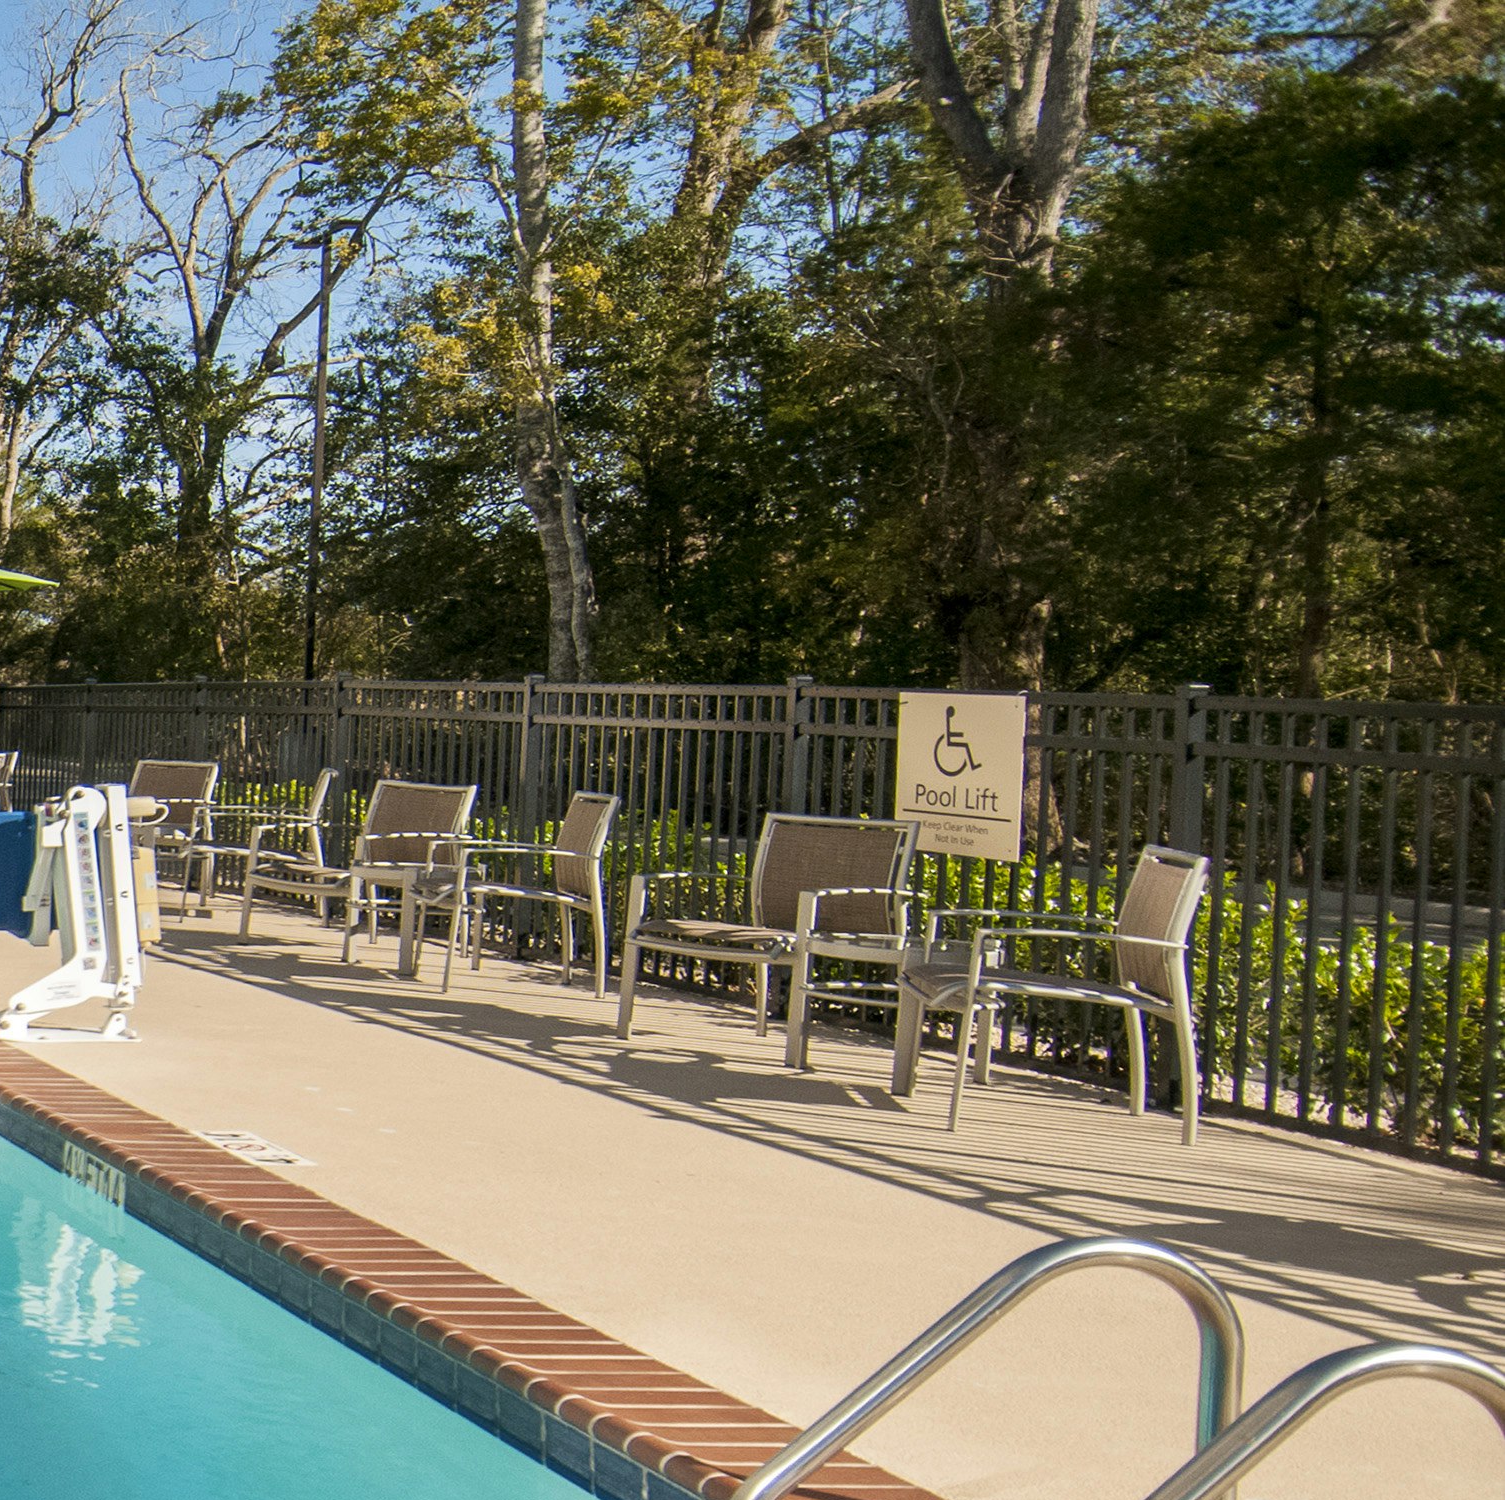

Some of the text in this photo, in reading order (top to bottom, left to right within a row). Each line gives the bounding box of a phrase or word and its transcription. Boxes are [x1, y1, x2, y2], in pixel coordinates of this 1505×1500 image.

[915, 783, 999, 812] Pool Lift
[922, 819, 989, 835] Keep Clear When
[934, 833, 950, 844] Not
[960, 836, 975, 847] Use
